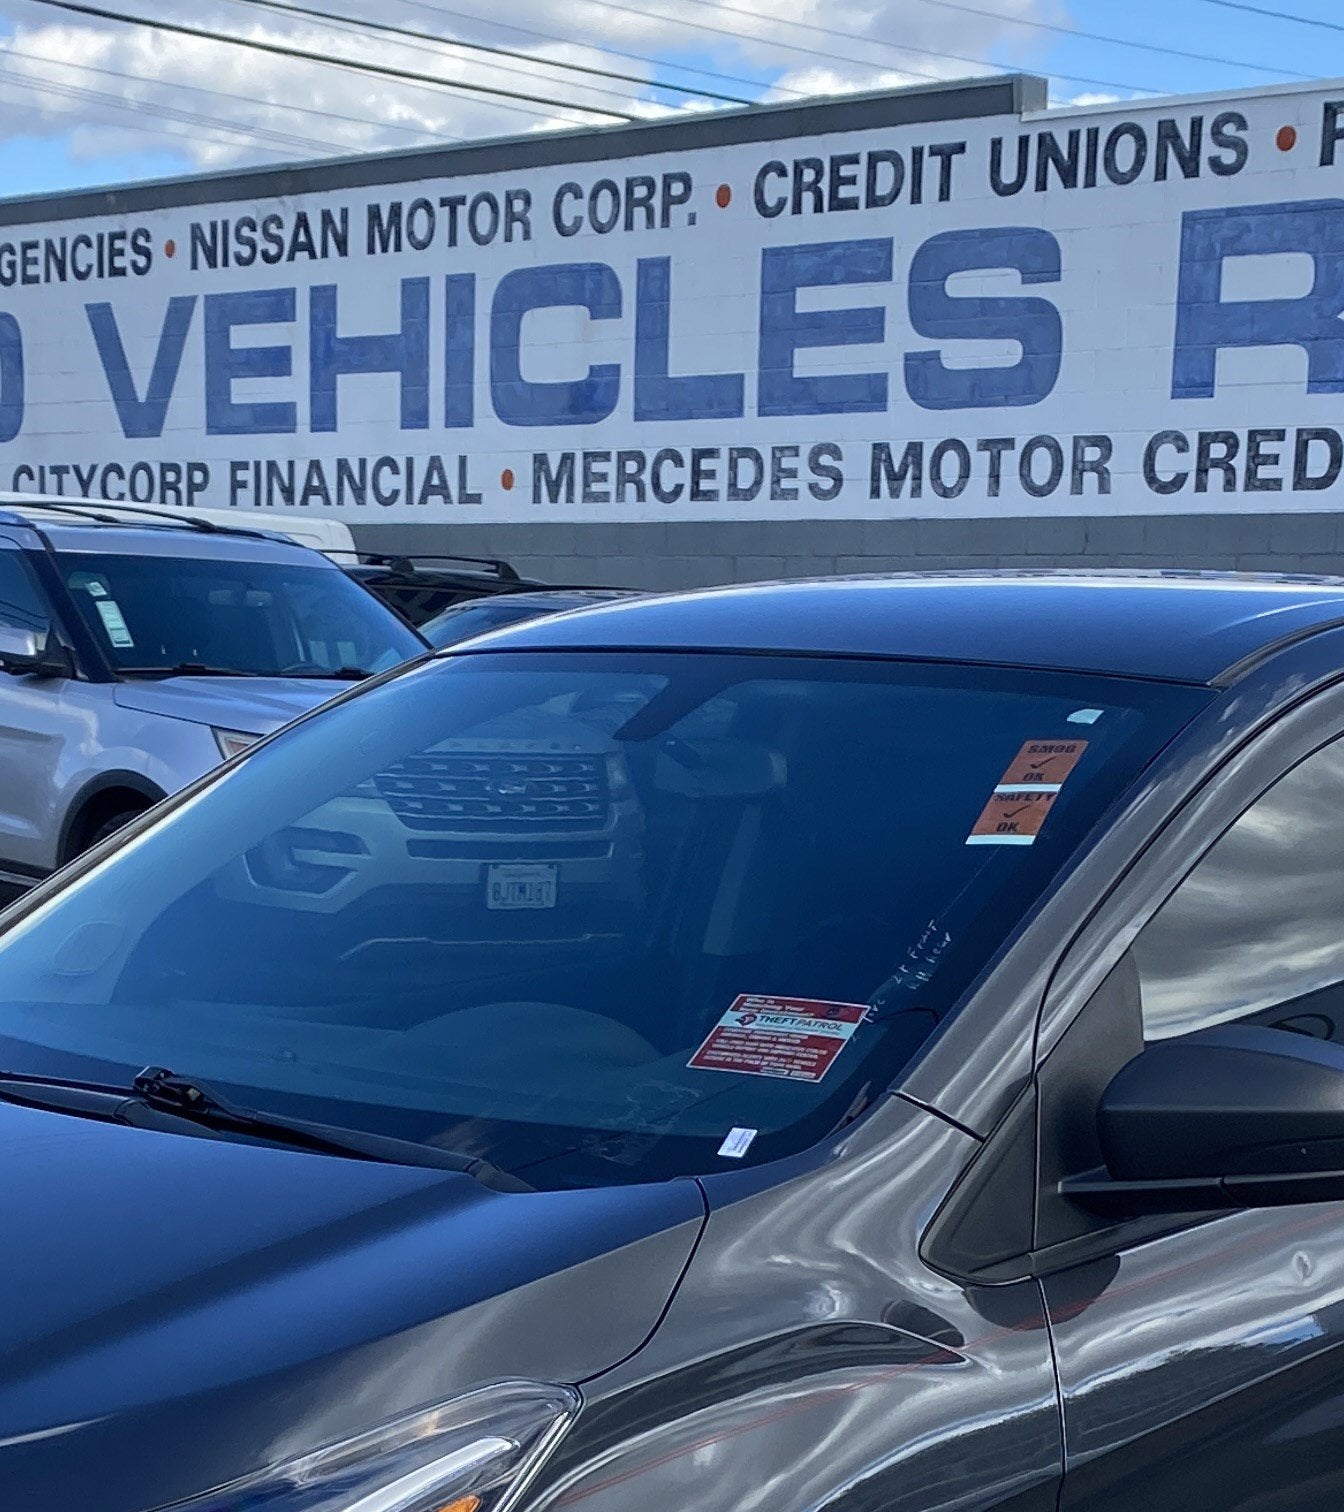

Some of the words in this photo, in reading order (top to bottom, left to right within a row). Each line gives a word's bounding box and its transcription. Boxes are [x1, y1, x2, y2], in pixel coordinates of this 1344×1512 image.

[191, 207, 348, 270] NISSAN
[367, 189, 532, 255] MOTOR
[553, 172, 696, 237] CORP.
[754, 141, 966, 218] CREDIT
[990, 112, 1248, 197] UNIONS
[84, 227, 1063, 439] VEHICLES
[13, 462, 209, 506] CITYCORP
[230, 455, 482, 506] FINANCIAL
[532, 443, 843, 504] MERCEDES
[870, 435, 1112, 499] MOTOR
[1023, 772, 1045, 782] OK
[996, 821, 1020, 833] OK
